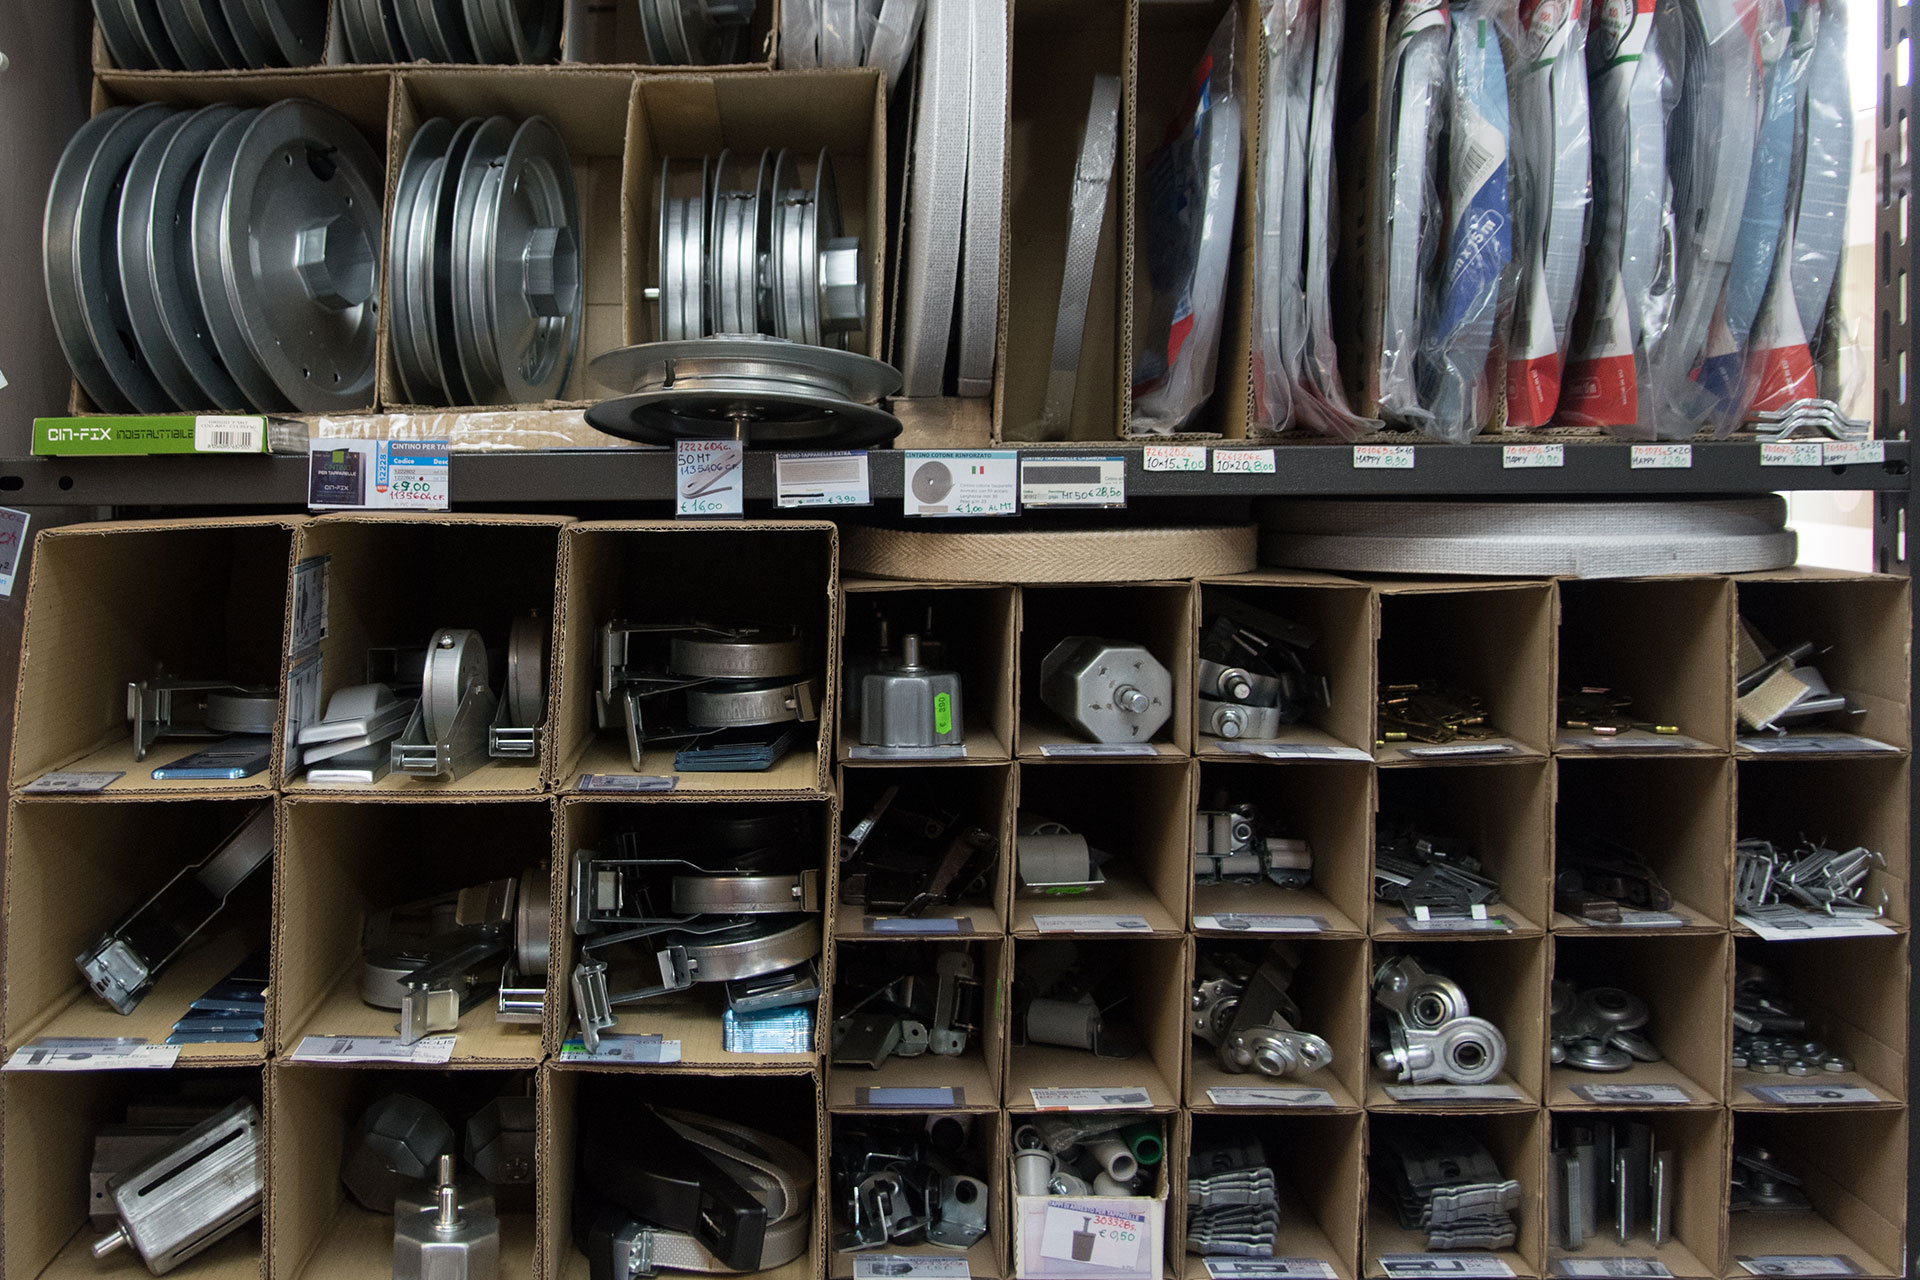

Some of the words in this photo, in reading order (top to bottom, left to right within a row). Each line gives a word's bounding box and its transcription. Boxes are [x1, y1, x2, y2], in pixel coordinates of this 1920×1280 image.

[48, 428, 111, 441] CIN-FIX
[678, 455, 696, 466] 50
[379, 454, 387, 481] 12228
[681, 501, 688, 512] €
[1099, 1230, 1106, 1238] €
[1109, 1230, 1136, 1243] 0,50
